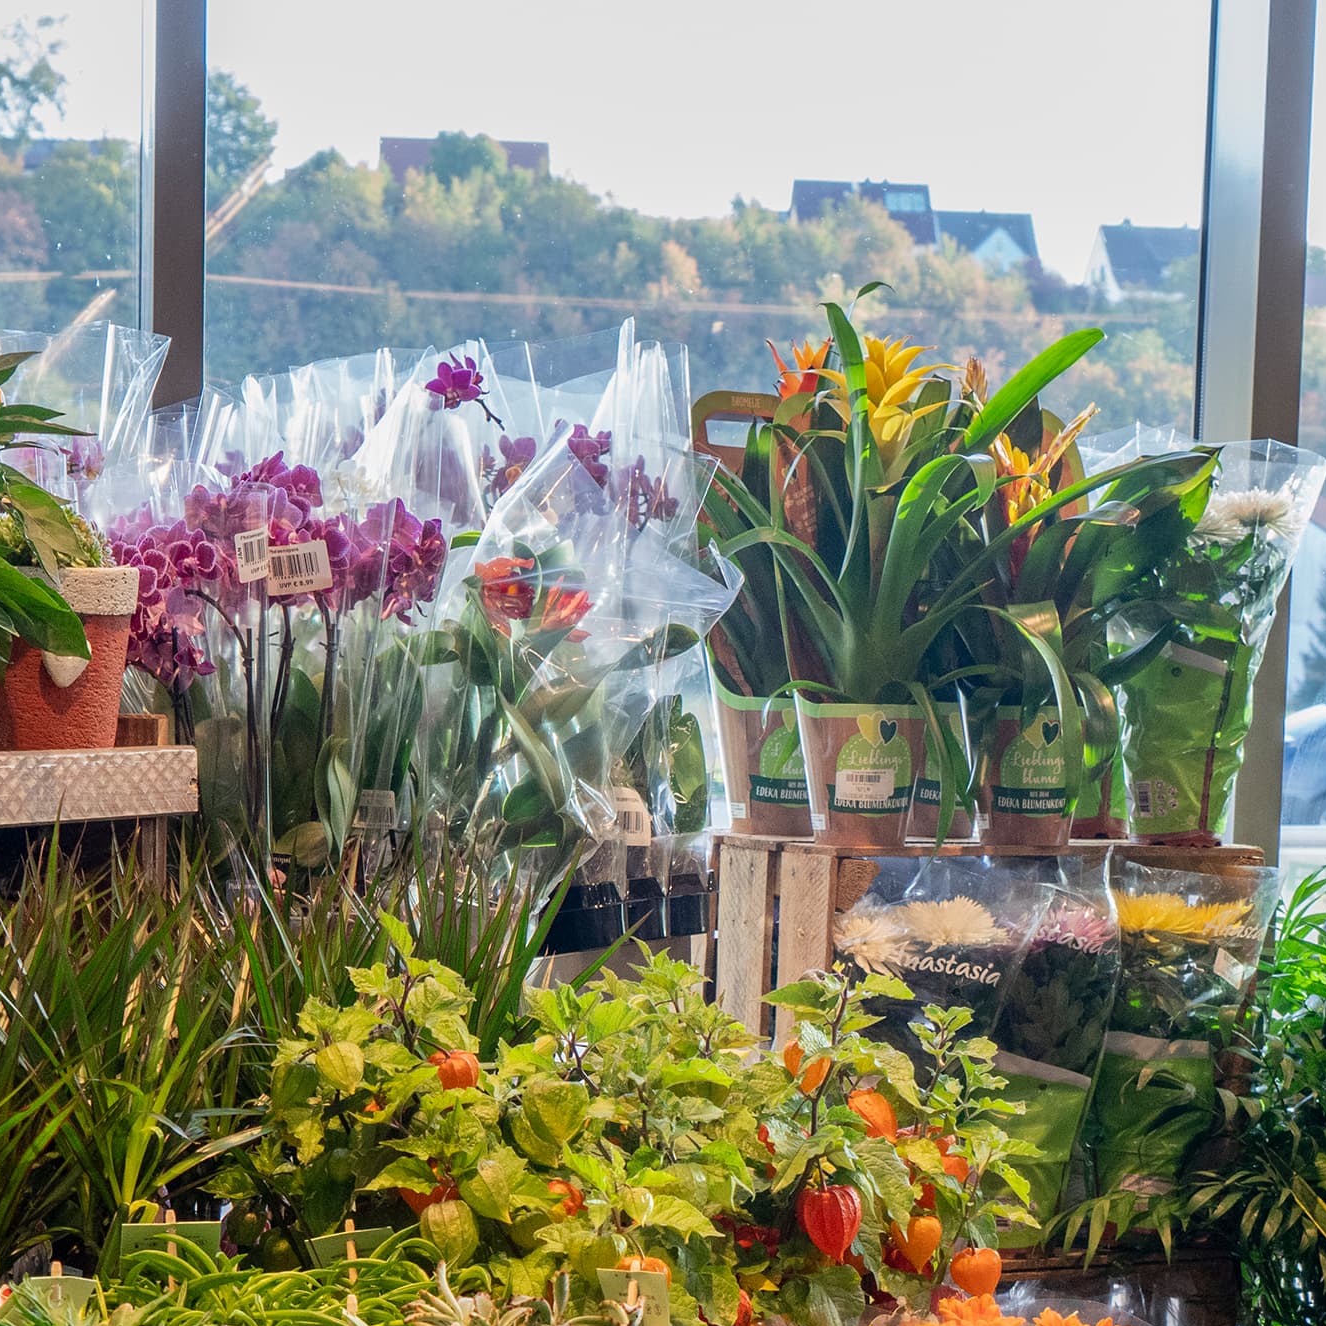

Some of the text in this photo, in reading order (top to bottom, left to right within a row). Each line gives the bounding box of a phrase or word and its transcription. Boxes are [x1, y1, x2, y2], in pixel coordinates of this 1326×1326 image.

[756, 786, 778, 798] EDEKA
[834, 799, 856, 809] EDEKA
[997, 796, 1020, 809] EDEKA
